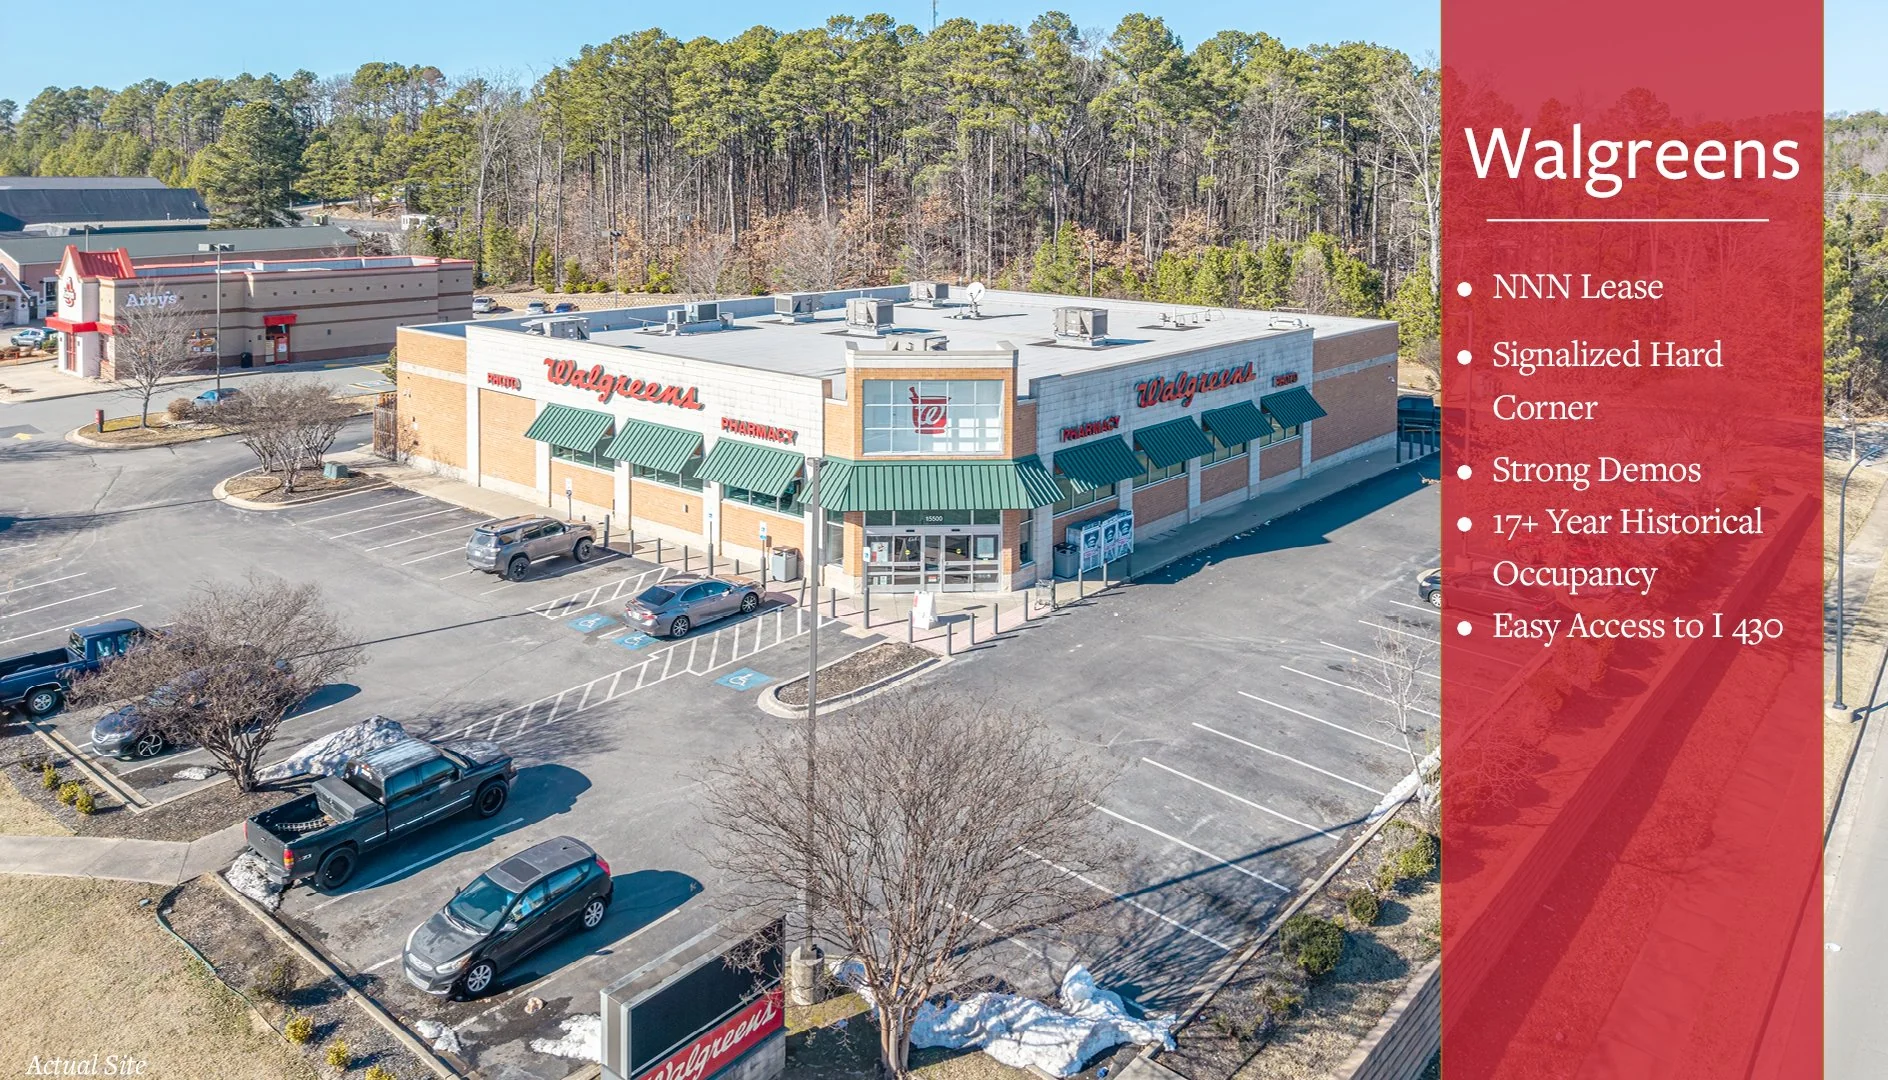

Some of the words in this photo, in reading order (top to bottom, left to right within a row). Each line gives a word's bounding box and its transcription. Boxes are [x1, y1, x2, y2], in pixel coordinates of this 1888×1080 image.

[126, 290, 177, 309] Arby's
[543, 357, 704, 411] Walgreens
[1136, 362, 1256, 408] Walgreens
[721, 417, 798, 446] PHARMACY
[1061, 415, 1121, 443] PHARMACY
